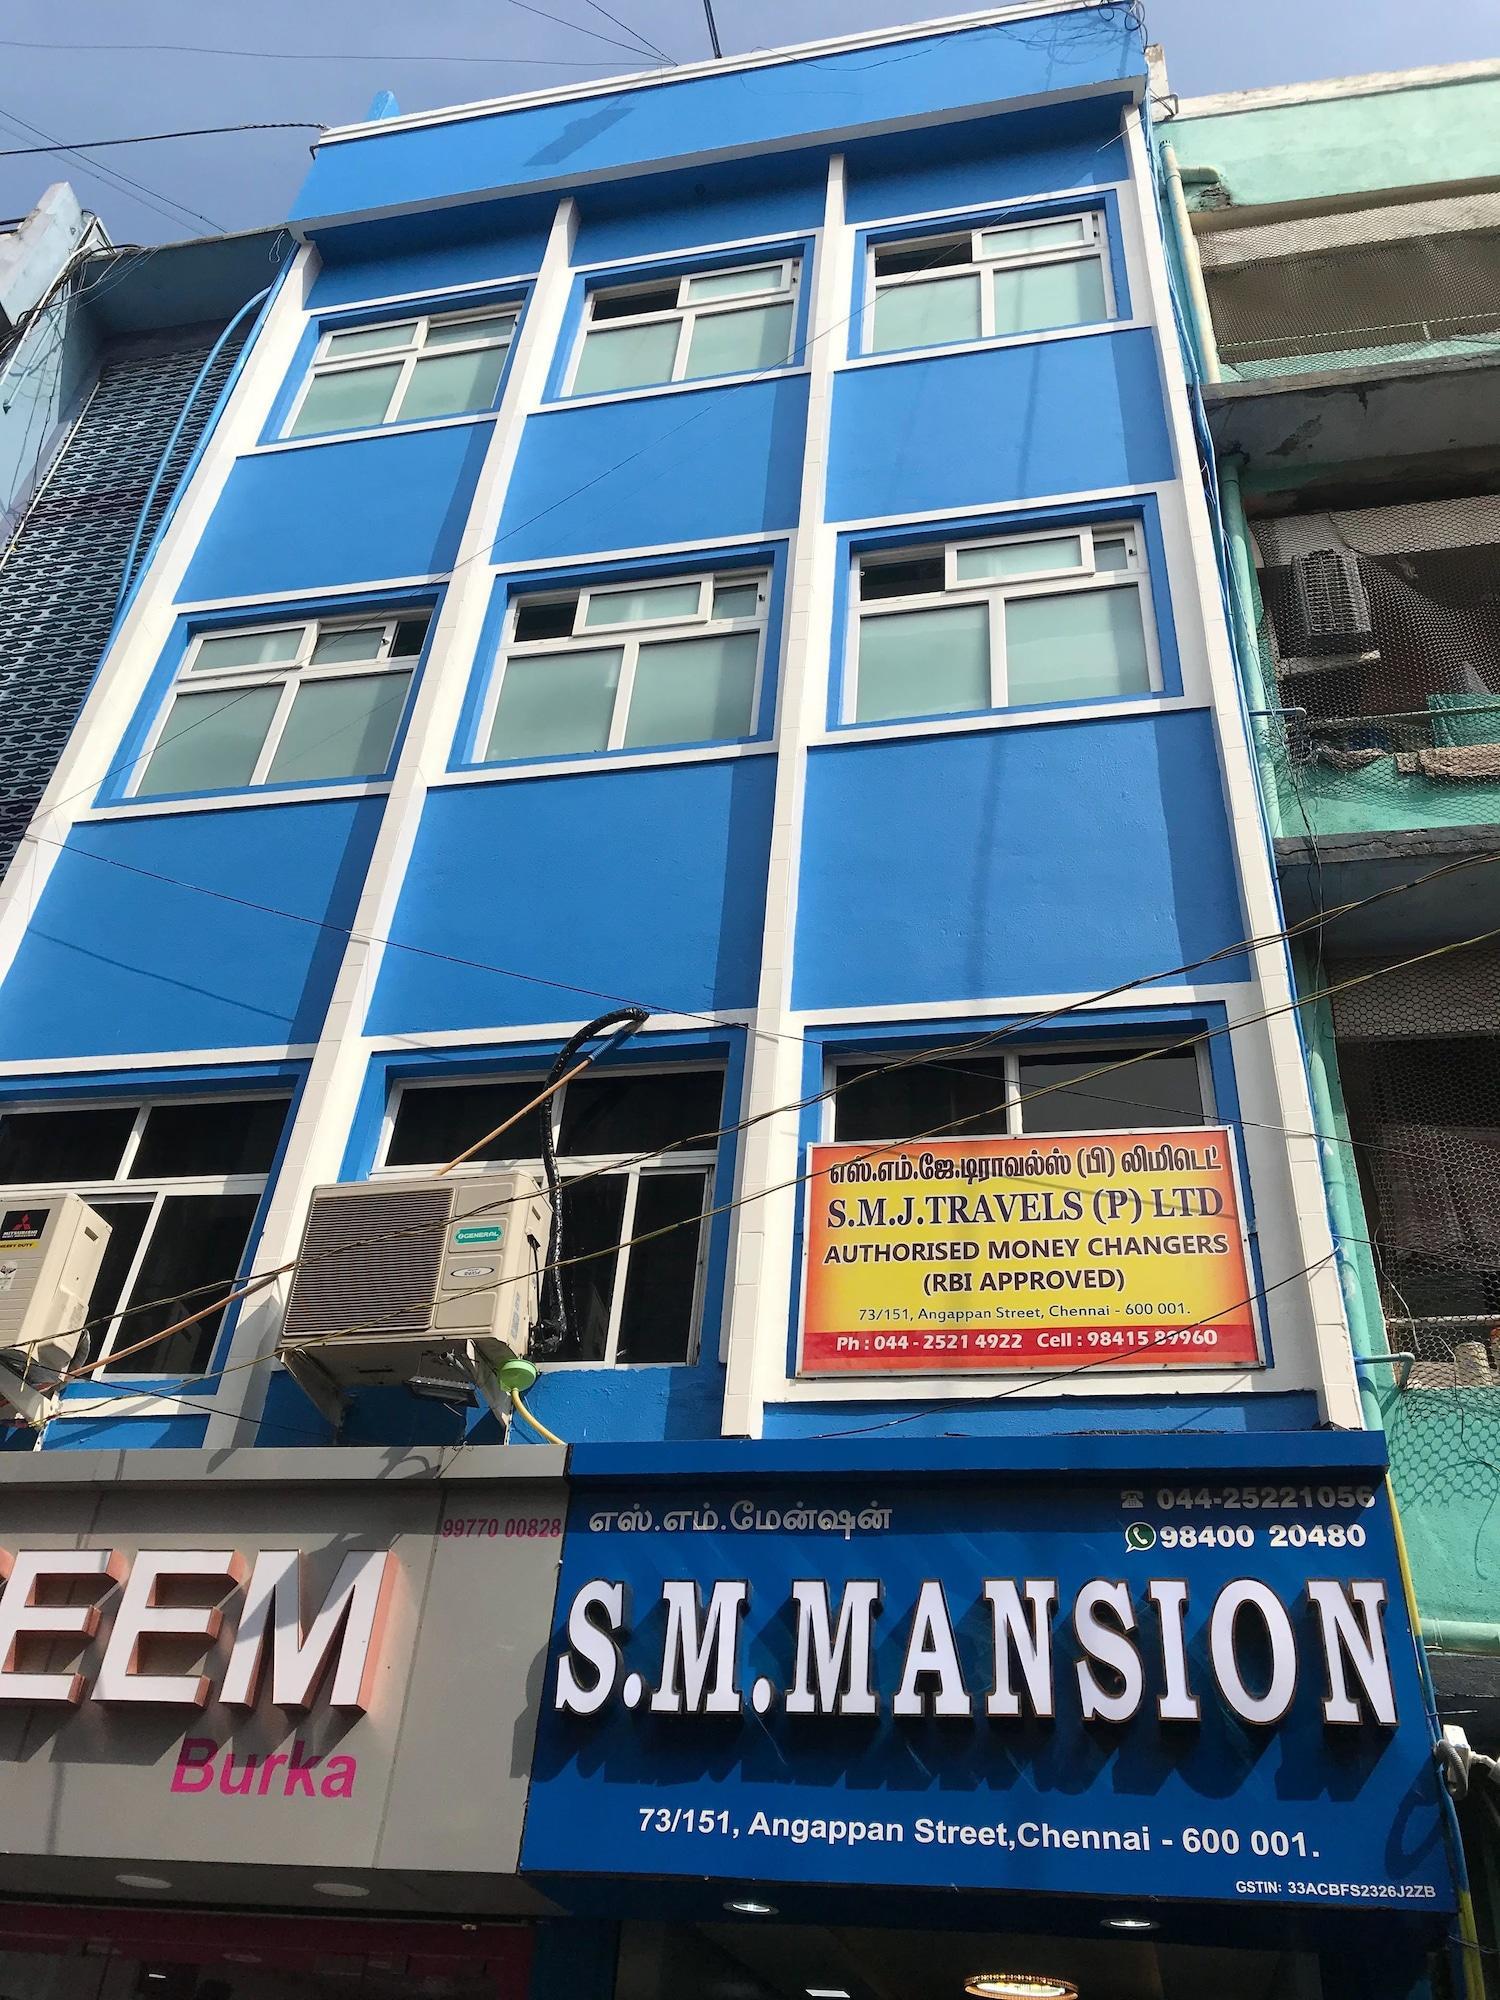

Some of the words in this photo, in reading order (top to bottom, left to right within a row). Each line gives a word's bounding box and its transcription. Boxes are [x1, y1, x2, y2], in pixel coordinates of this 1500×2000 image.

[1077, 1145, 1116, 1179] (பி)
[827, 1191, 1083, 1229] S.M.J.TRAVELS
[1093, 1188, 1143, 1225] (P)
[1151, 1186, 1224, 1219] LTD
[824, 1241, 980, 1264] AUTHORISED
[988, 1238, 1080, 1260] MONEY
[1087, 1234, 1229, 1256] CHANGERS
[923, 1272, 972, 1296] (RBI
[980, 1268, 1126, 1292] APPROVED)
[859, 1308, 914, 1323] 73/151,
[918, 1307, 992, 1323] Angappan
[996, 1305, 1044, 1319] Street,
[1049, 1304, 1110, 1317] Chennai
[1125, 1303, 1153, 1315] 600
[1157, 1302, 1191, 1315] 001.
[836, 1337, 860, 1351] Ph
[874, 1336, 908, 1350] 044
[923, 1335, 969, 1349] 2521
[975, 1334, 1023, 1349] 4922
[1037, 1333, 1073, 1349] Cell
[1087, 1332, 1149, 1347] 98415
[1154, 1330, 1218, 1346] 89960
[1156, 1485, 1376, 1510] 044-25221056
[442, 1518, 499, 1538] 99770
[505, 1518, 562, 1538] 00828
[1159, 1524, 1255, 1548] 98400
[1269, 1523, 1367, 1548] 20480
[0, 1548, 393, 1708] EEM
[170, 1738, 358, 1799] Burka
[639, 1808, 740, 1839] 73/151,
[748, 1811, 904, 1846] Angappan
[1182, 1827, 1240, 1855] 600
[1250, 1830, 1320, 1858] 001.
[1235, 1880, 1283, 1894] GSTIN:
[1287, 1881, 1437, 1899] 33ACBFS2326J2ZB
